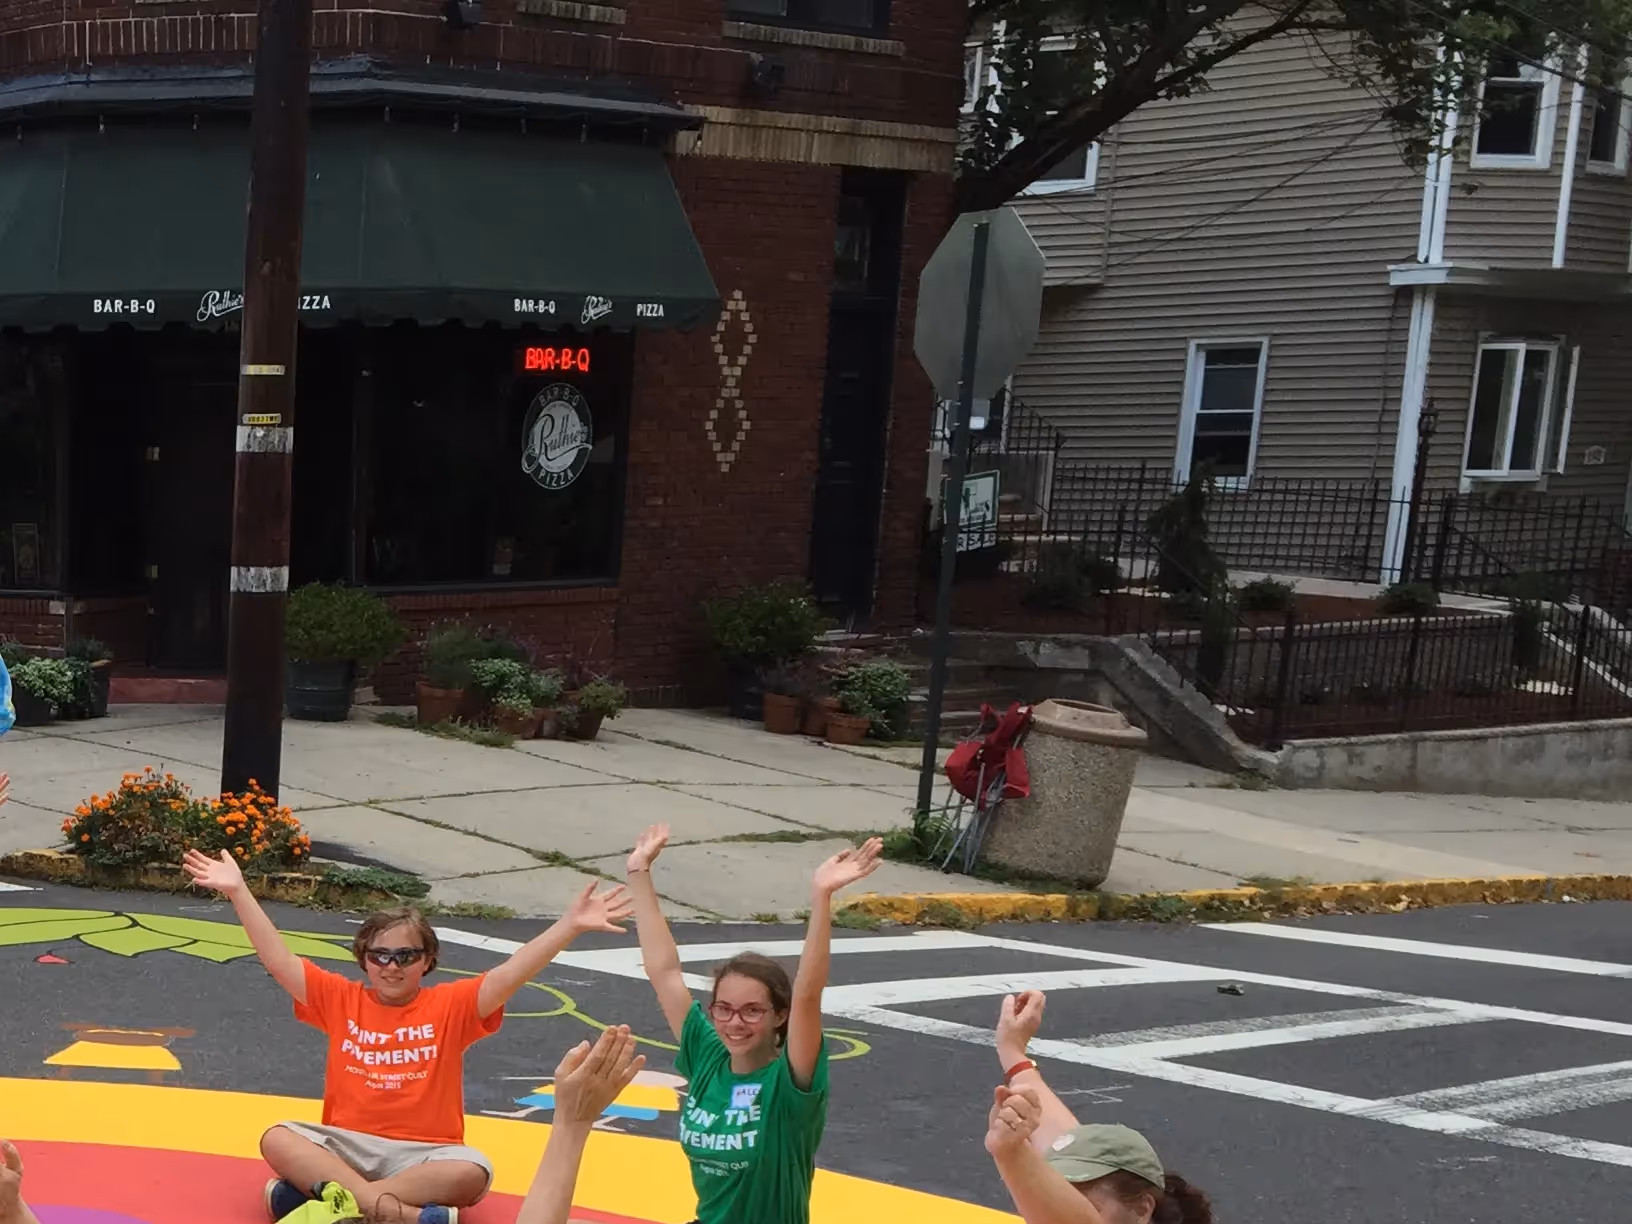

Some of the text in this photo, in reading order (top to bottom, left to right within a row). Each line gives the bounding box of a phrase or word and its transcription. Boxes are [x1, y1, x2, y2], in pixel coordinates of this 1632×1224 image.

[93, 299, 155, 313] BAR-B-Q
[297, 295, 331, 309] IZZA
[514, 298, 556, 314] BAR-B-Q
[637, 303, 664, 317] PIZZA
[525, 347, 590, 372] BAR-B-Q
[538, 469, 574, 487] PIZZA
[347, 1018, 435, 1045] PAINT THE
